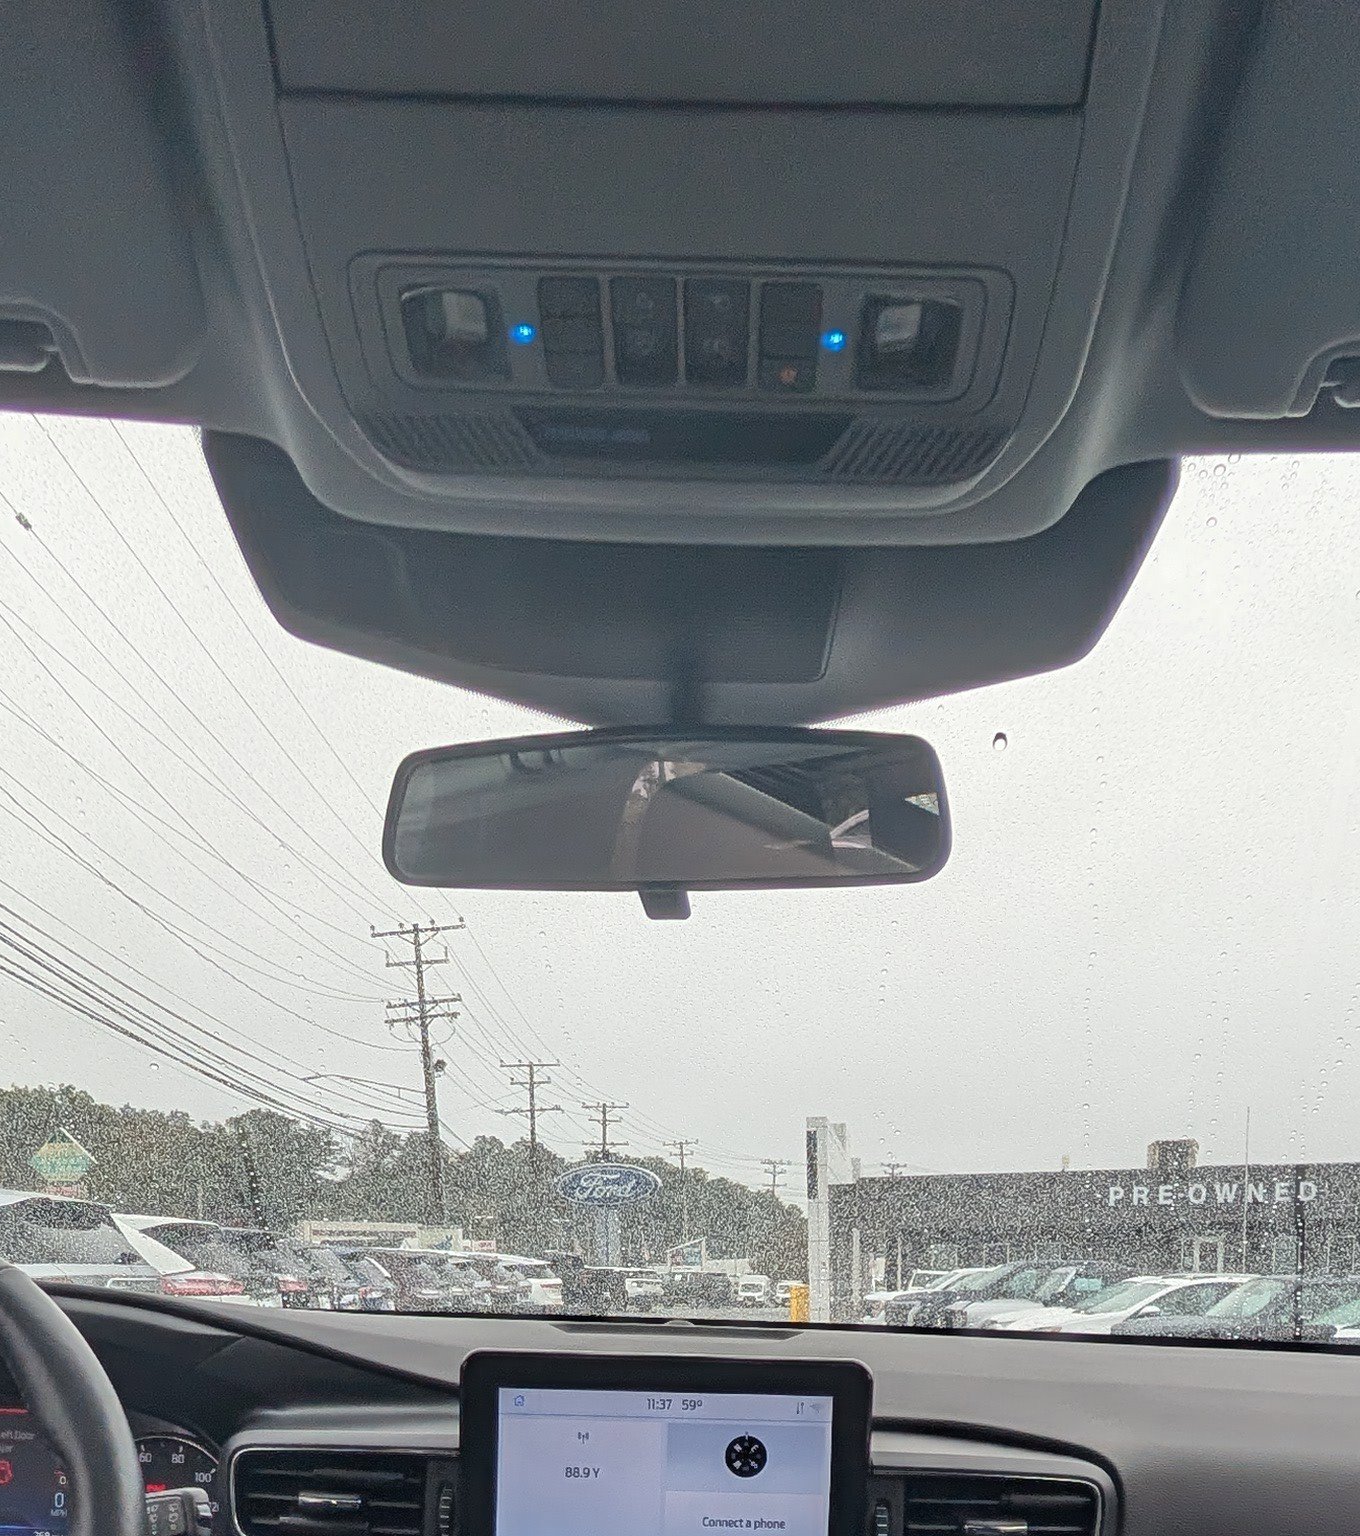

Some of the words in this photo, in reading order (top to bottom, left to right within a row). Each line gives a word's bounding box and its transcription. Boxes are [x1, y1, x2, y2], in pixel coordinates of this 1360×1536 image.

[576, 1172, 637, 1200] Ford
[646, 1397, 673, 1411] 11:37
[171, 1453, 185, 1464] 80
[194, 1472, 212, 1483] 100
[565, 1466, 590, 1478] 88.9
[592, 1467, 601, 1478] Y
[54, 1492, 65, 1508] 0
[702, 1516, 744, 1528] Connect
[753, 1517, 786, 1530] phone
